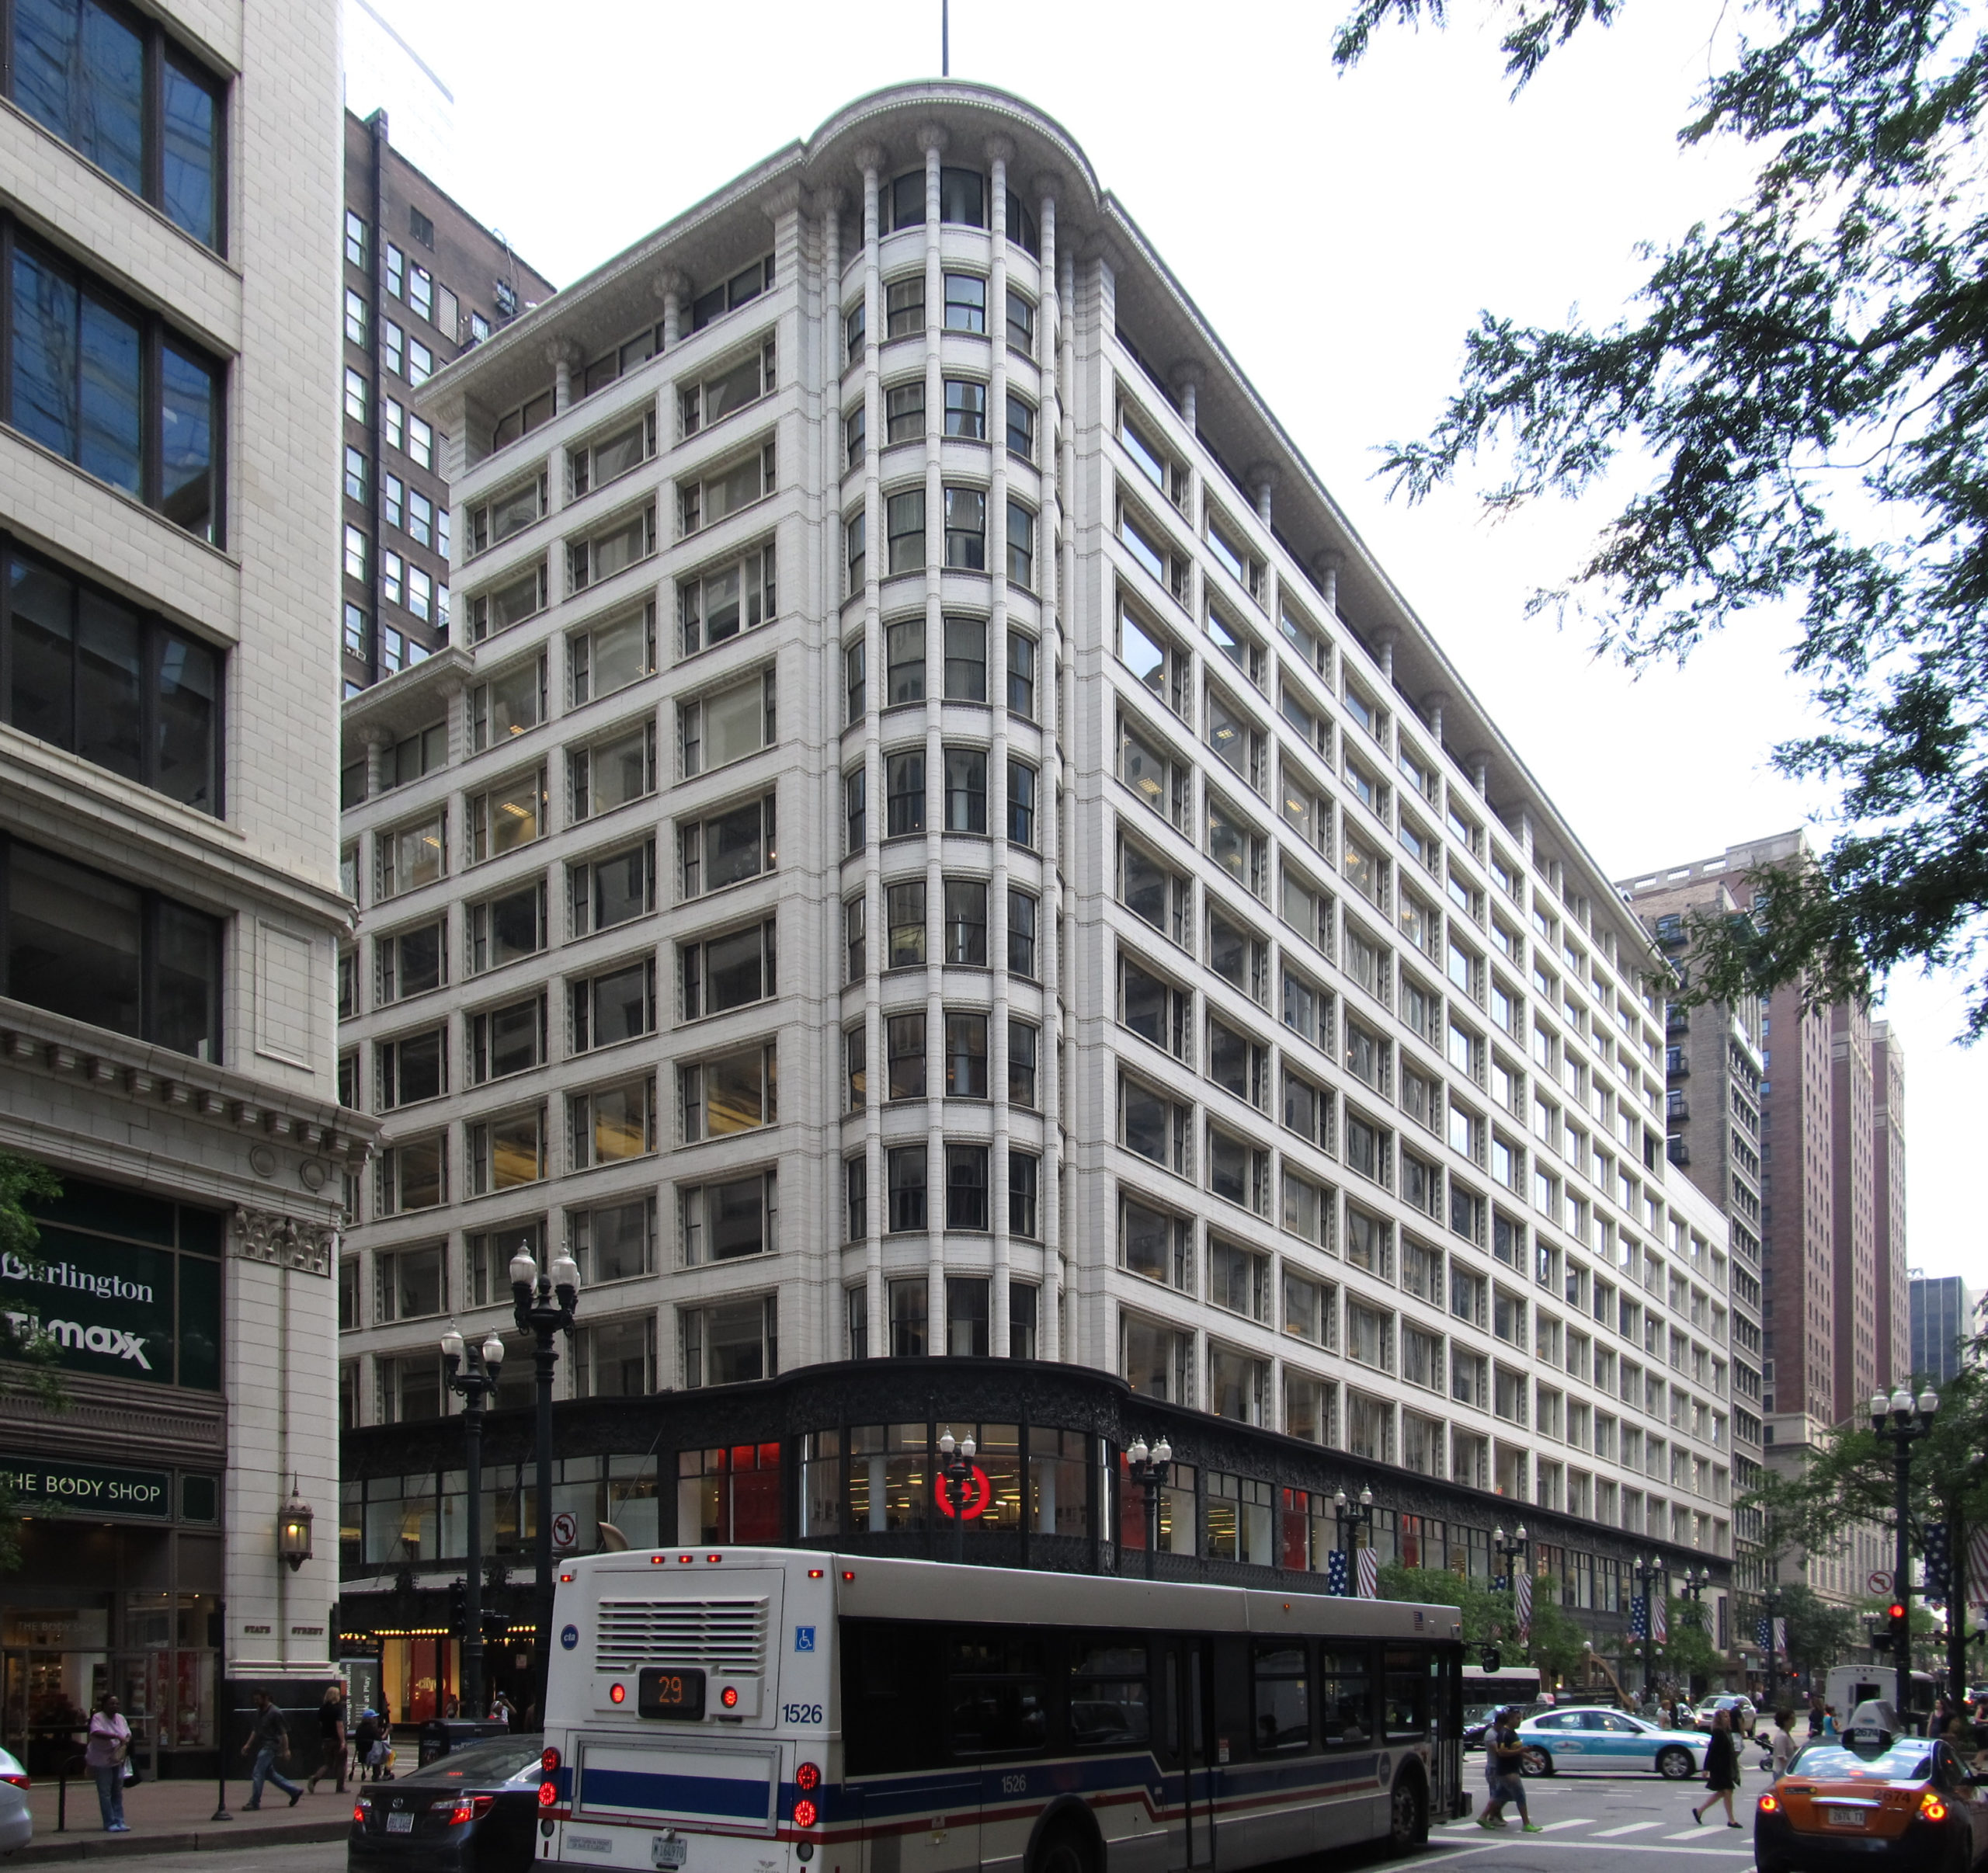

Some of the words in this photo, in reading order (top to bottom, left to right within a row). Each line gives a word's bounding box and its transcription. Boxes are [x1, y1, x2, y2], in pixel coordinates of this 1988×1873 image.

[2, 1251, 154, 1303] Burlington
[1, 1472, 37, 1491] HE
[46, 1475, 104, 1497] BODY
[108, 1482, 161, 1503] SHOP
[18, 1621, 38, 1631] THE
[42, 1621, 70, 1631] BODY
[244, 1625, 271, 1634] STATE
[291, 1626, 324, 1635] STREET
[363, 1694, 370, 1703] at
[659, 1676, 683, 1703] 29
[782, 1703, 822, 1724] 1526
[1854, 1727, 1879, 1738] 2674
[1001, 1774, 1027, 1794] 1526
[1873, 1788, 1911, 1804] 2674
